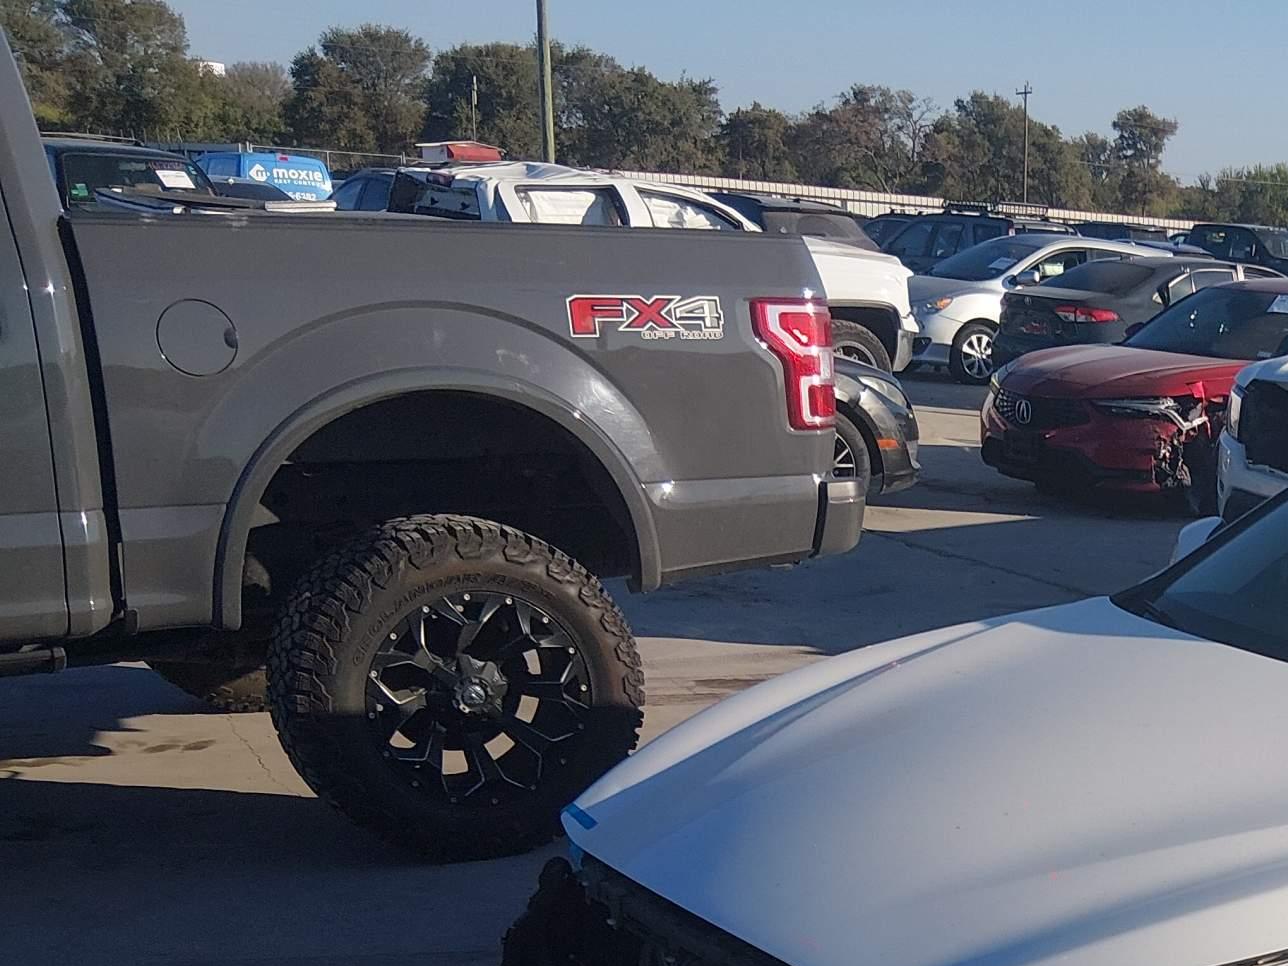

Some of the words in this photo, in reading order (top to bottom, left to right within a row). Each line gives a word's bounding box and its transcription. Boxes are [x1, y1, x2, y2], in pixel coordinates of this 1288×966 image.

[273, 168, 322, 181] moxie
[566, 295, 724, 337] FX4
[641, 330, 675, 340] OFF
[680, 330, 724, 340] ROAD
